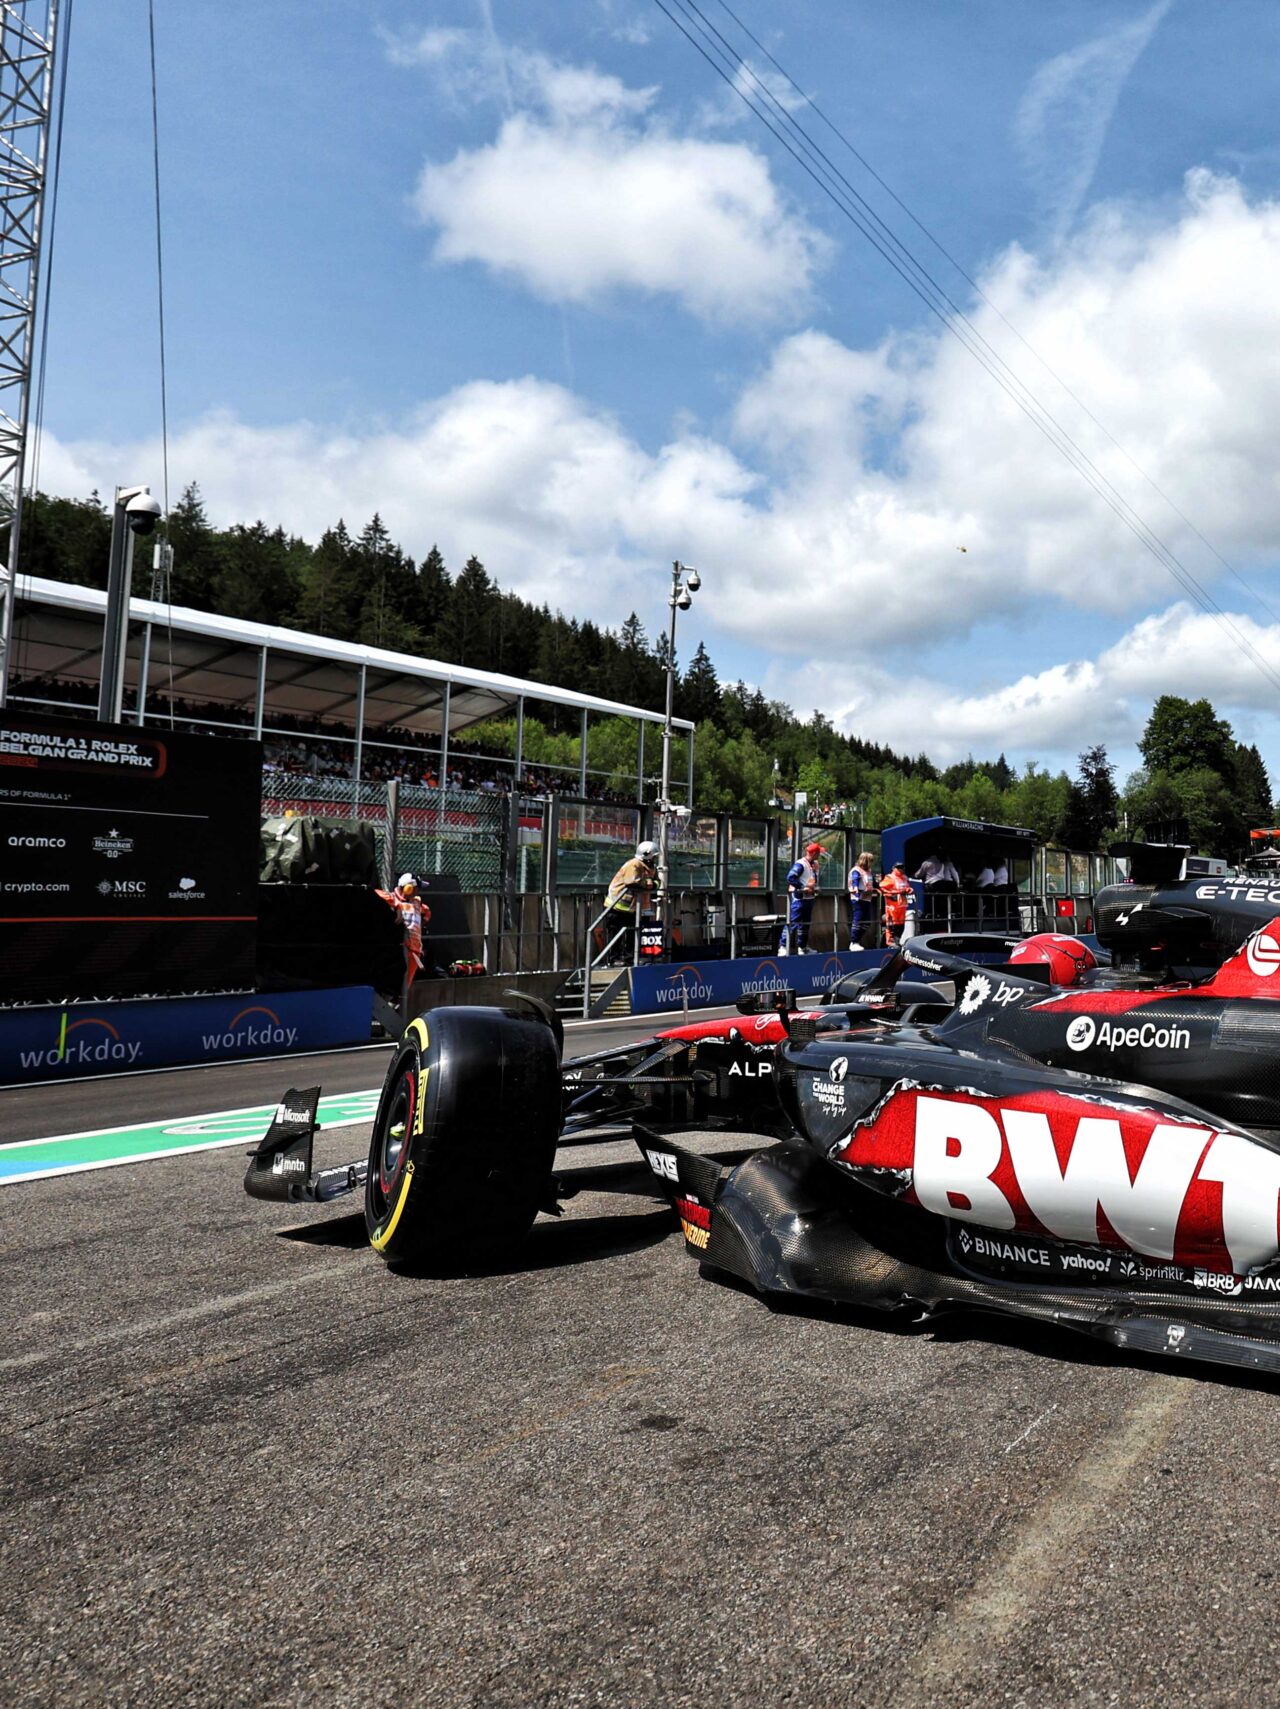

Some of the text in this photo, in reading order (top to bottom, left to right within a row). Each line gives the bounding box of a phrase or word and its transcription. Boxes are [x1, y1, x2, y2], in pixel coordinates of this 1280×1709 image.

[0, 730, 138, 754] FORMULA 1 ROLEX
[0, 742, 153, 767] BELGIAN GRAND PRIX
[23, 791, 62, 800] FORMULA
[8, 836, 66, 847] aramco
[95, 840, 131, 849] Heineken
[4, 883, 70, 893] crypto.com
[114, 881, 146, 892] MSC
[168, 891, 205, 900] salesforce
[641, 936, 662, 945] BOX
[991, 981, 1024, 1007] bp
[202, 1025, 297, 1050] workday
[1097, 1023, 1190, 1051] ApeCoin
[20, 1038, 142, 1068] workday
[813, 1082, 845, 1095] CHANGE
[819, 1094, 845, 1105] WORLD
[284, 1109, 310, 1123] Microsoft
[283, 1159, 305, 1172] mntn
[975, 1237, 1051, 1266] BINANCE
[1060, 1253, 1112, 1273] yahoo!
[1139, 1265, 1184, 1281] sprinklr
[1208, 1273, 1235, 1289] BRB
